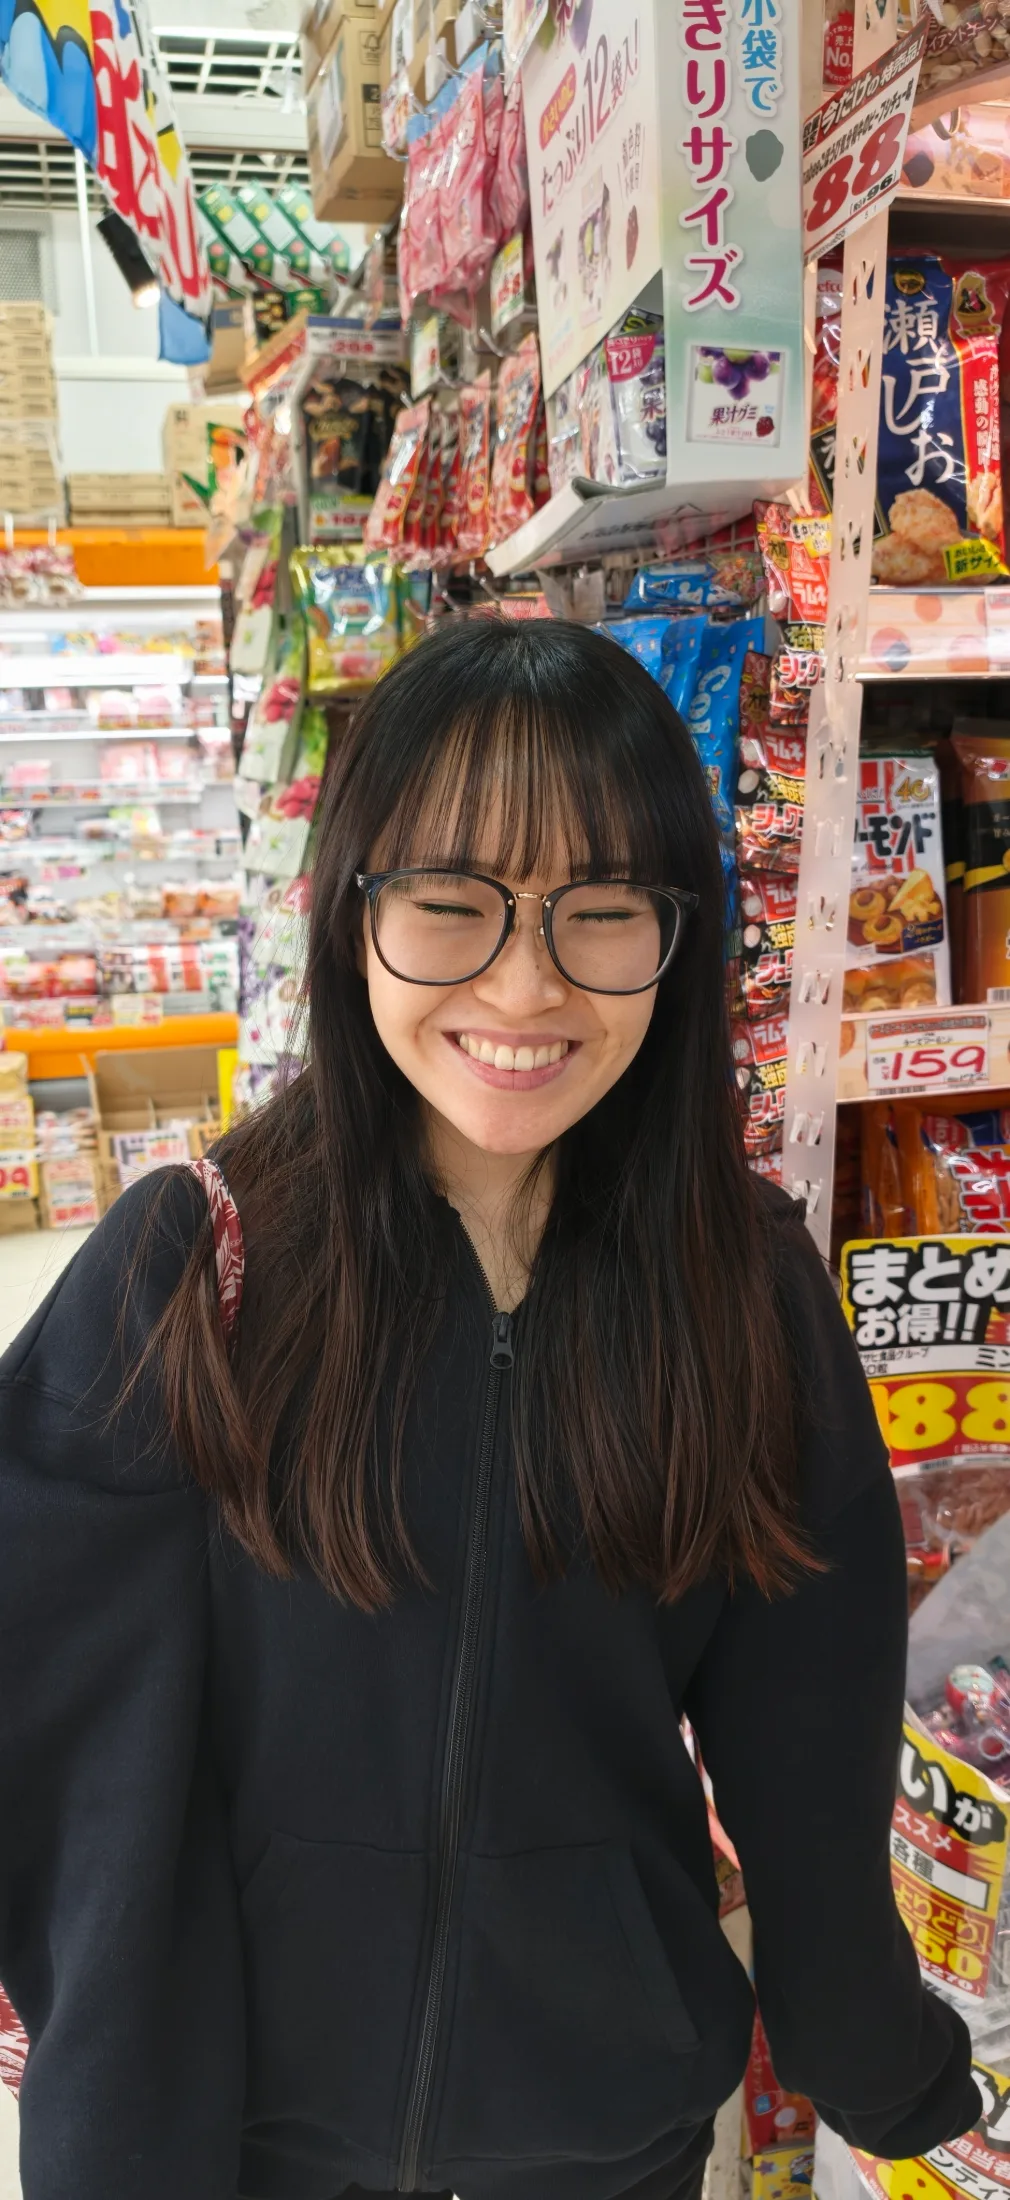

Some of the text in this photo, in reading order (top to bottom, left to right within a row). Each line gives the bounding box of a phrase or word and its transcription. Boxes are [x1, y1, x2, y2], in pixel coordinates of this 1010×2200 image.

[883, 299, 953, 487] 瀬戸しお
[854, 812, 936, 857] ーモンド
[852, 1247, 1010, 1304] まとめ
[856, 1302, 979, 1346] お得!!
[860, 1346, 930, 1362] サヒ食品グループ
